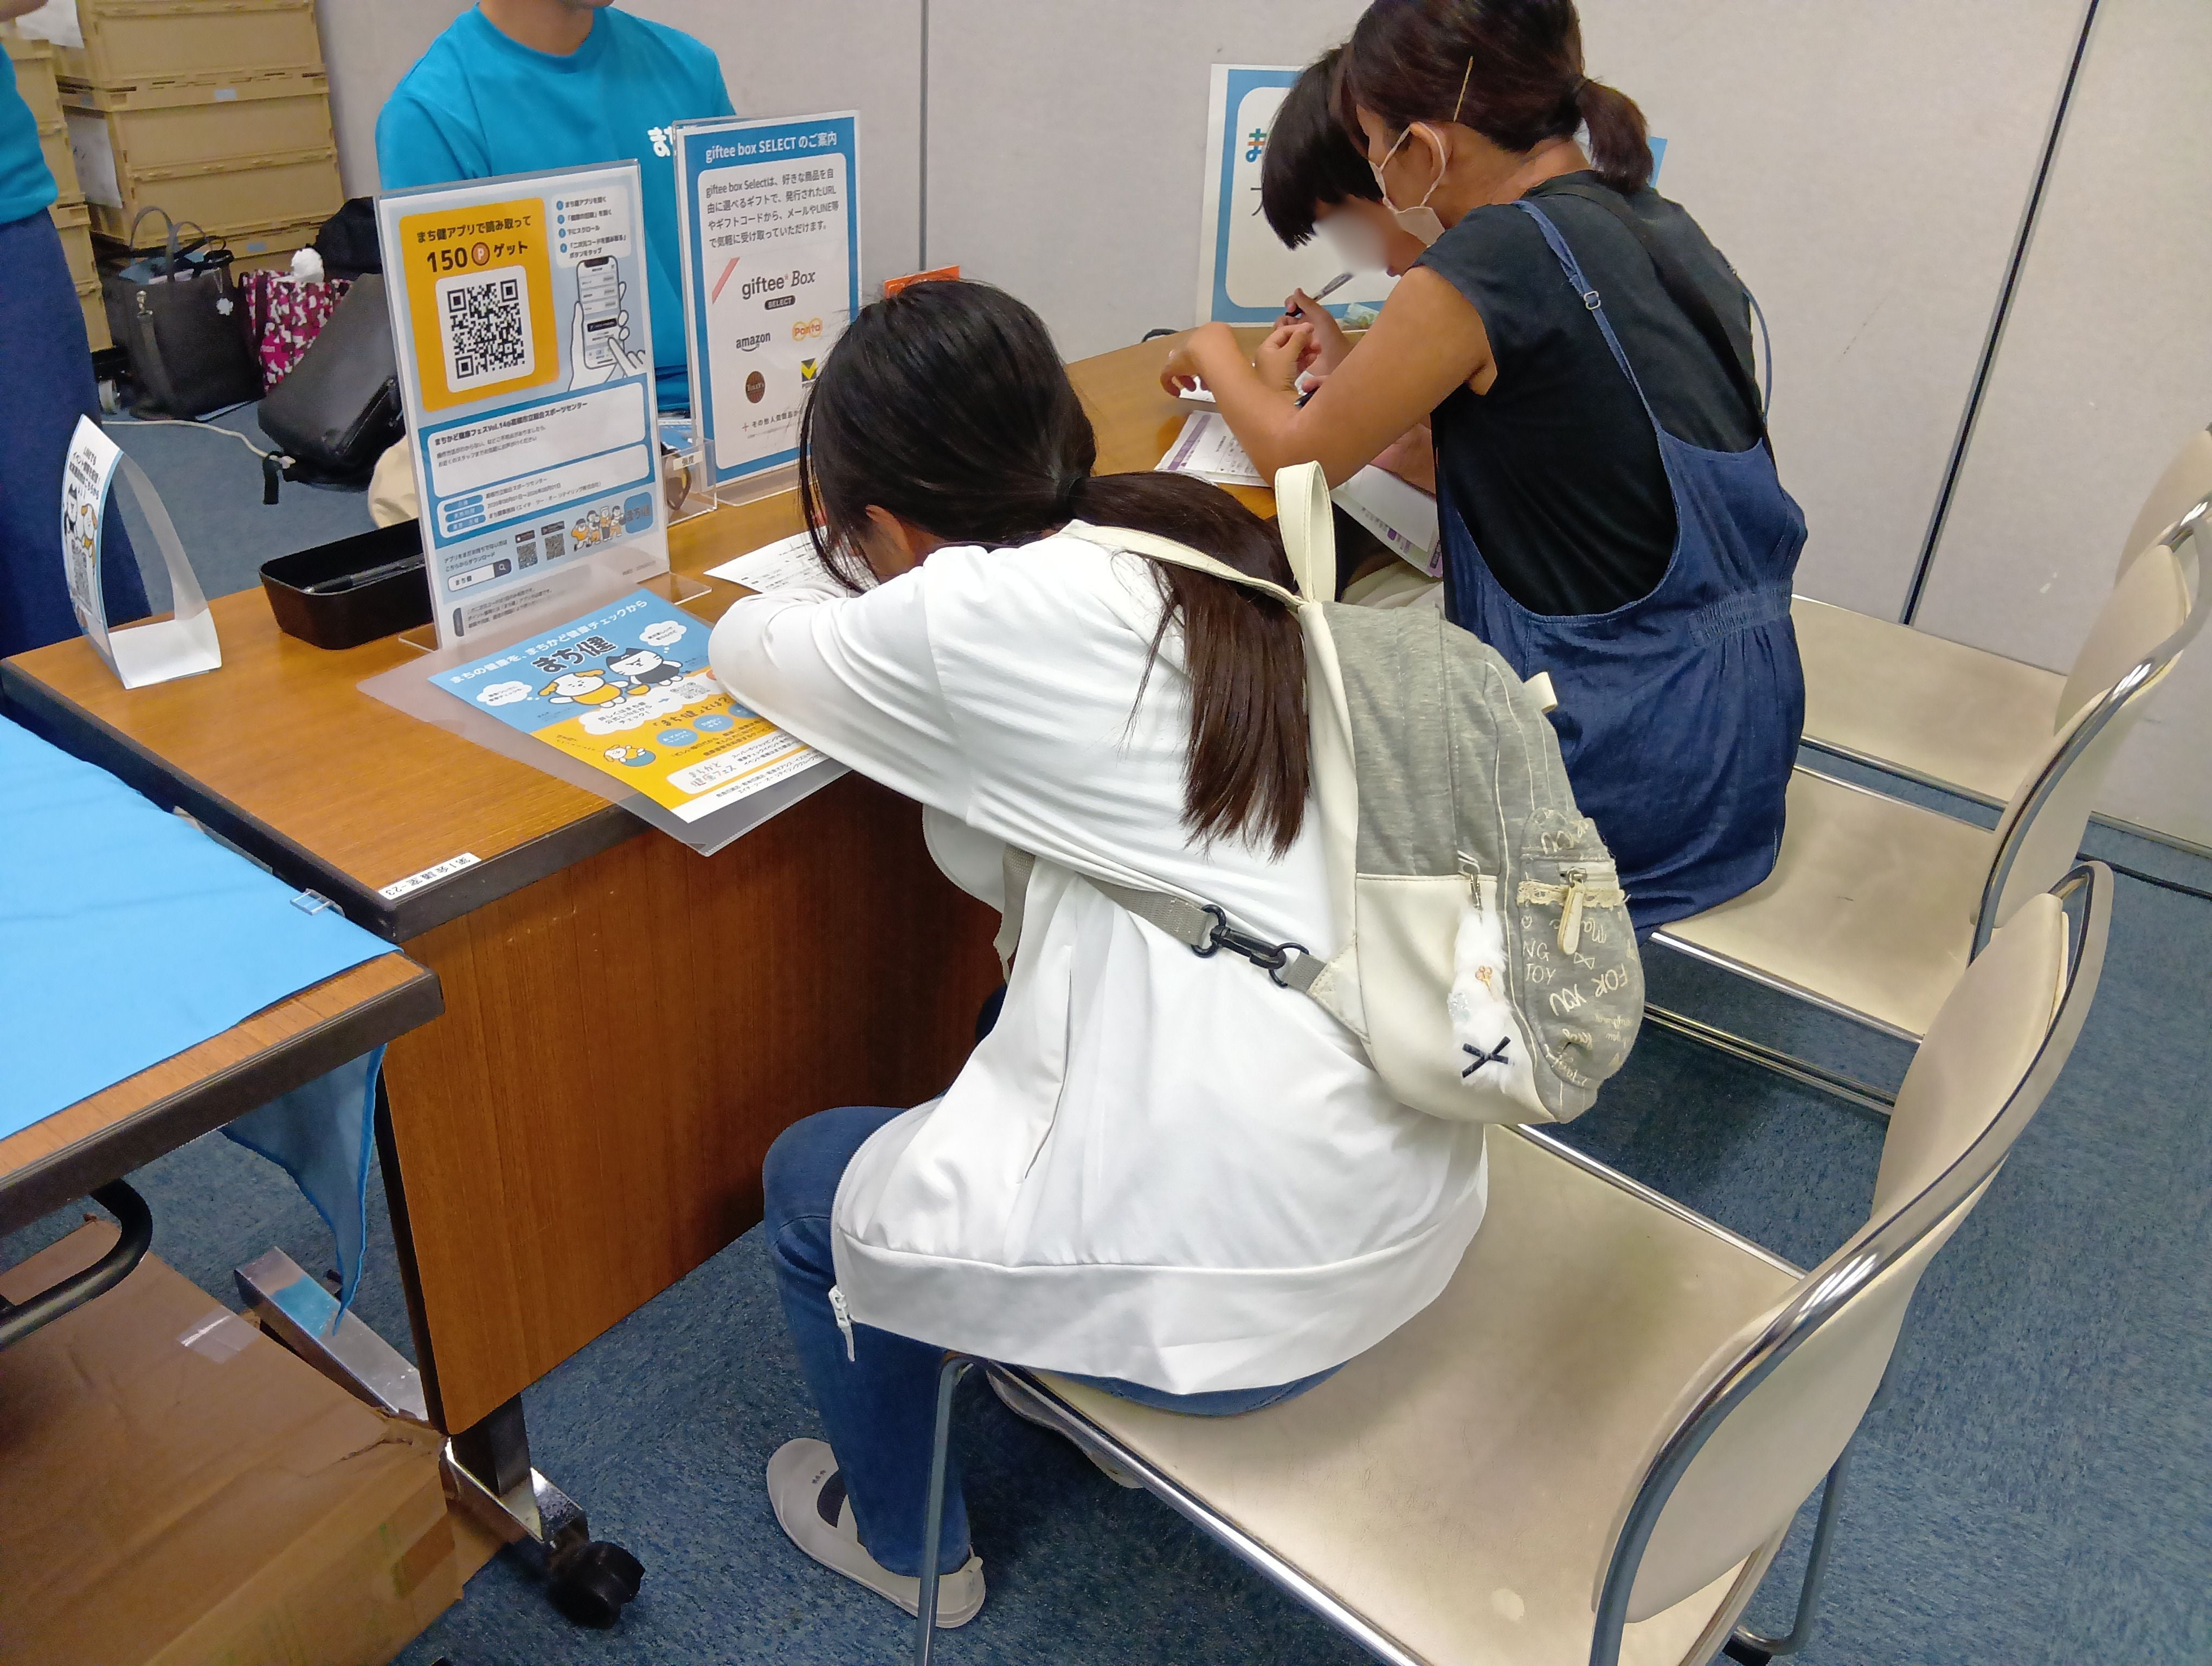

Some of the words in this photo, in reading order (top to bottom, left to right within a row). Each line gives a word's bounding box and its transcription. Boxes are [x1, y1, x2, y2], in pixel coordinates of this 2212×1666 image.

[706, 145, 735, 163] giftee
[738, 143, 757, 156] box
[759, 137, 796, 153] SELECT
[799, 131, 837, 148] のご案内
[706, 183, 727, 198] giftee
[729, 183, 742, 192] box
[417, 215, 531, 243] まち健アプリで読み取って
[709, 220, 826, 248] で気軽に受け取っていただけます。
[427, 247, 467, 272] 150
[493, 241, 528, 258] ゲット
[742, 276, 785, 300] giftee
[790, 271, 815, 287] Box
[768, 298, 793, 308] SELECT
[736, 332, 771, 349] amazon
[795, 324, 820, 336] Ponta
[450, 600, 648, 683] まちの健康を、まちかど健康チェックから
[531, 636, 617, 672] まち健
[385, 856, 471, 896] 第1会議室-23
[1591, 963, 1628, 997] FOR
